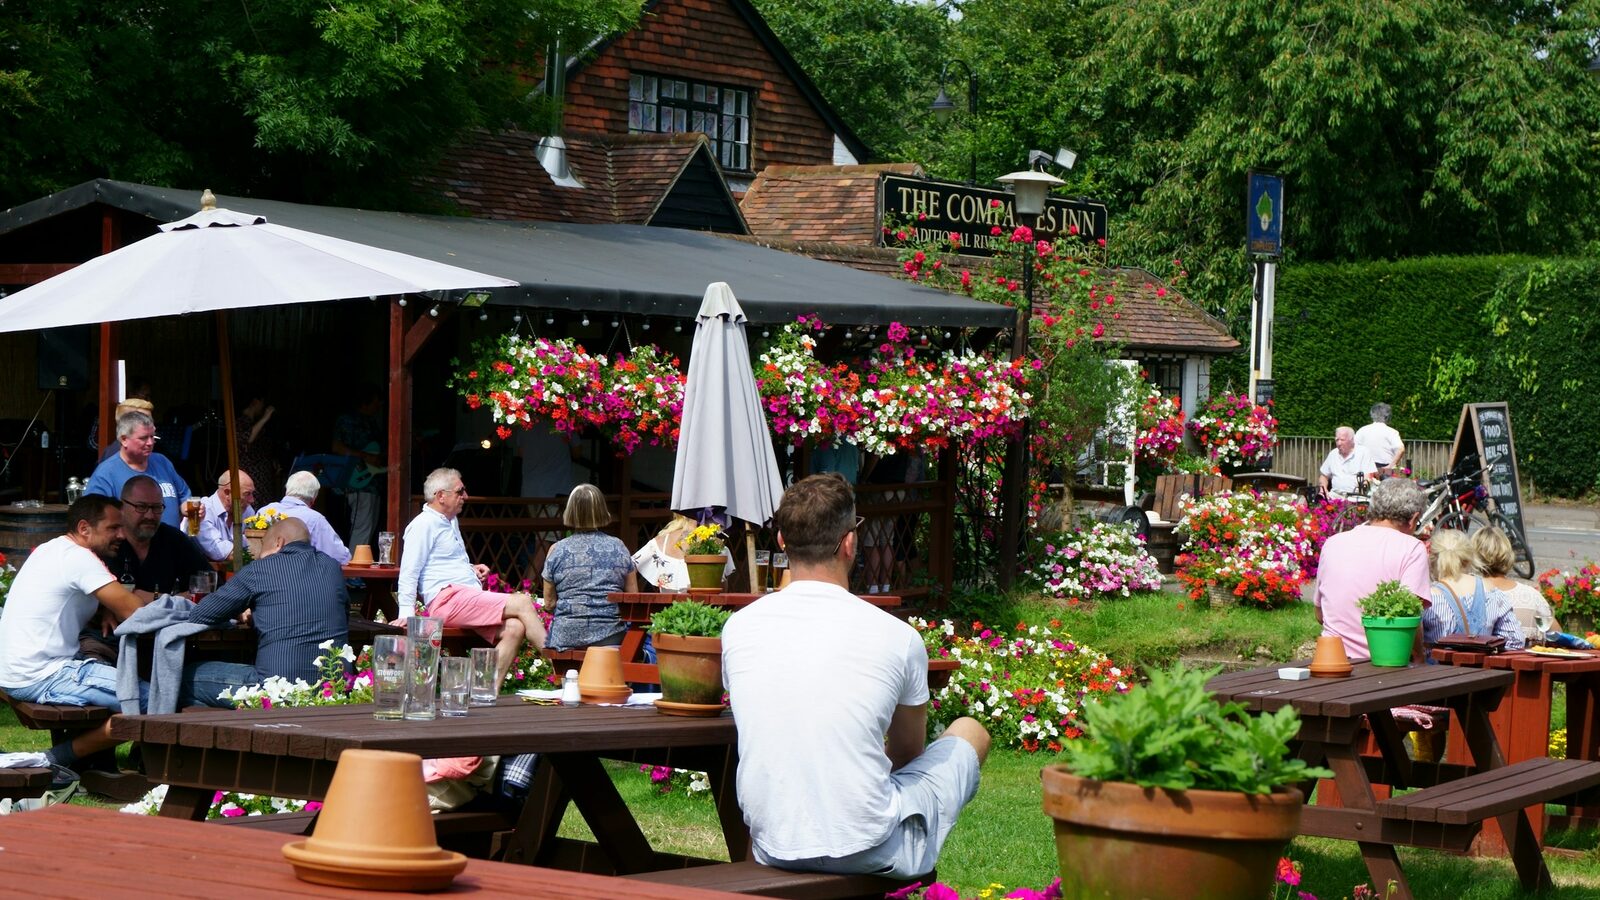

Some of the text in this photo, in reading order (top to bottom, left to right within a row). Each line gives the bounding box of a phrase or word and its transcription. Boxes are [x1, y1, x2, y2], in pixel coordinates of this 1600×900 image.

[898, 187, 1096, 237] THE COMPAES INN
[912, 227, 971, 248] ADITIOAL
[1484, 424, 1501, 438] FOOD
